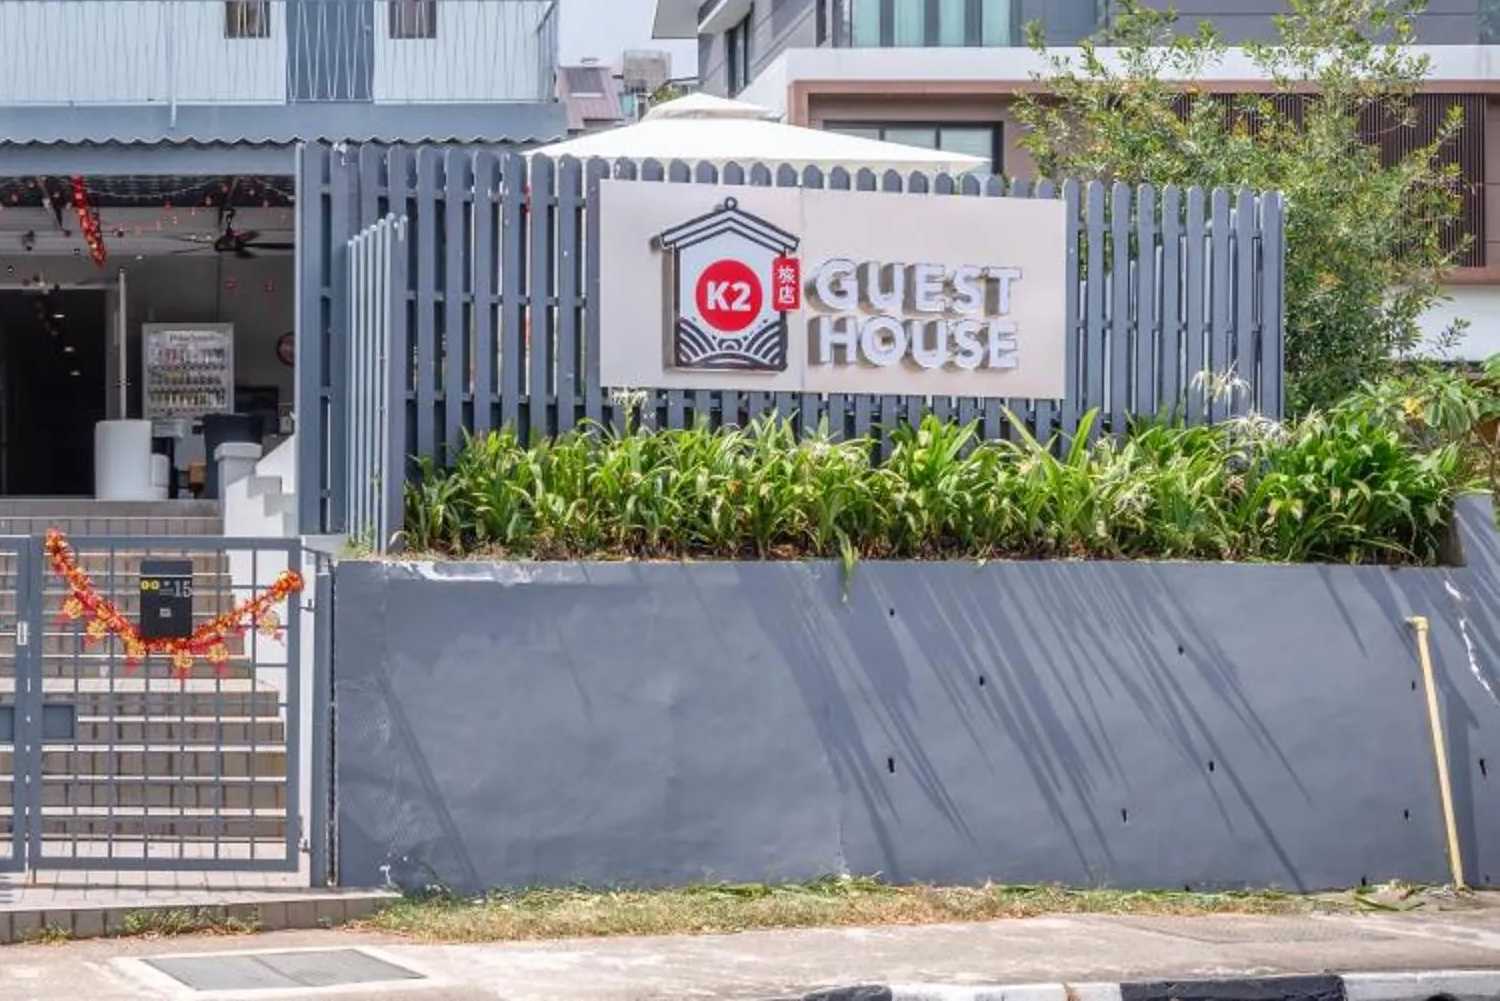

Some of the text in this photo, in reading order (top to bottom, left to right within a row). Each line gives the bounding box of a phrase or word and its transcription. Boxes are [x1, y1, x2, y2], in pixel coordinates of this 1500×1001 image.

[707, 280, 751, 311] K2
[808, 257, 1023, 316] GUEST
[808, 314, 1019, 370] HOUSE
[174, 580, 193, 598] 15
